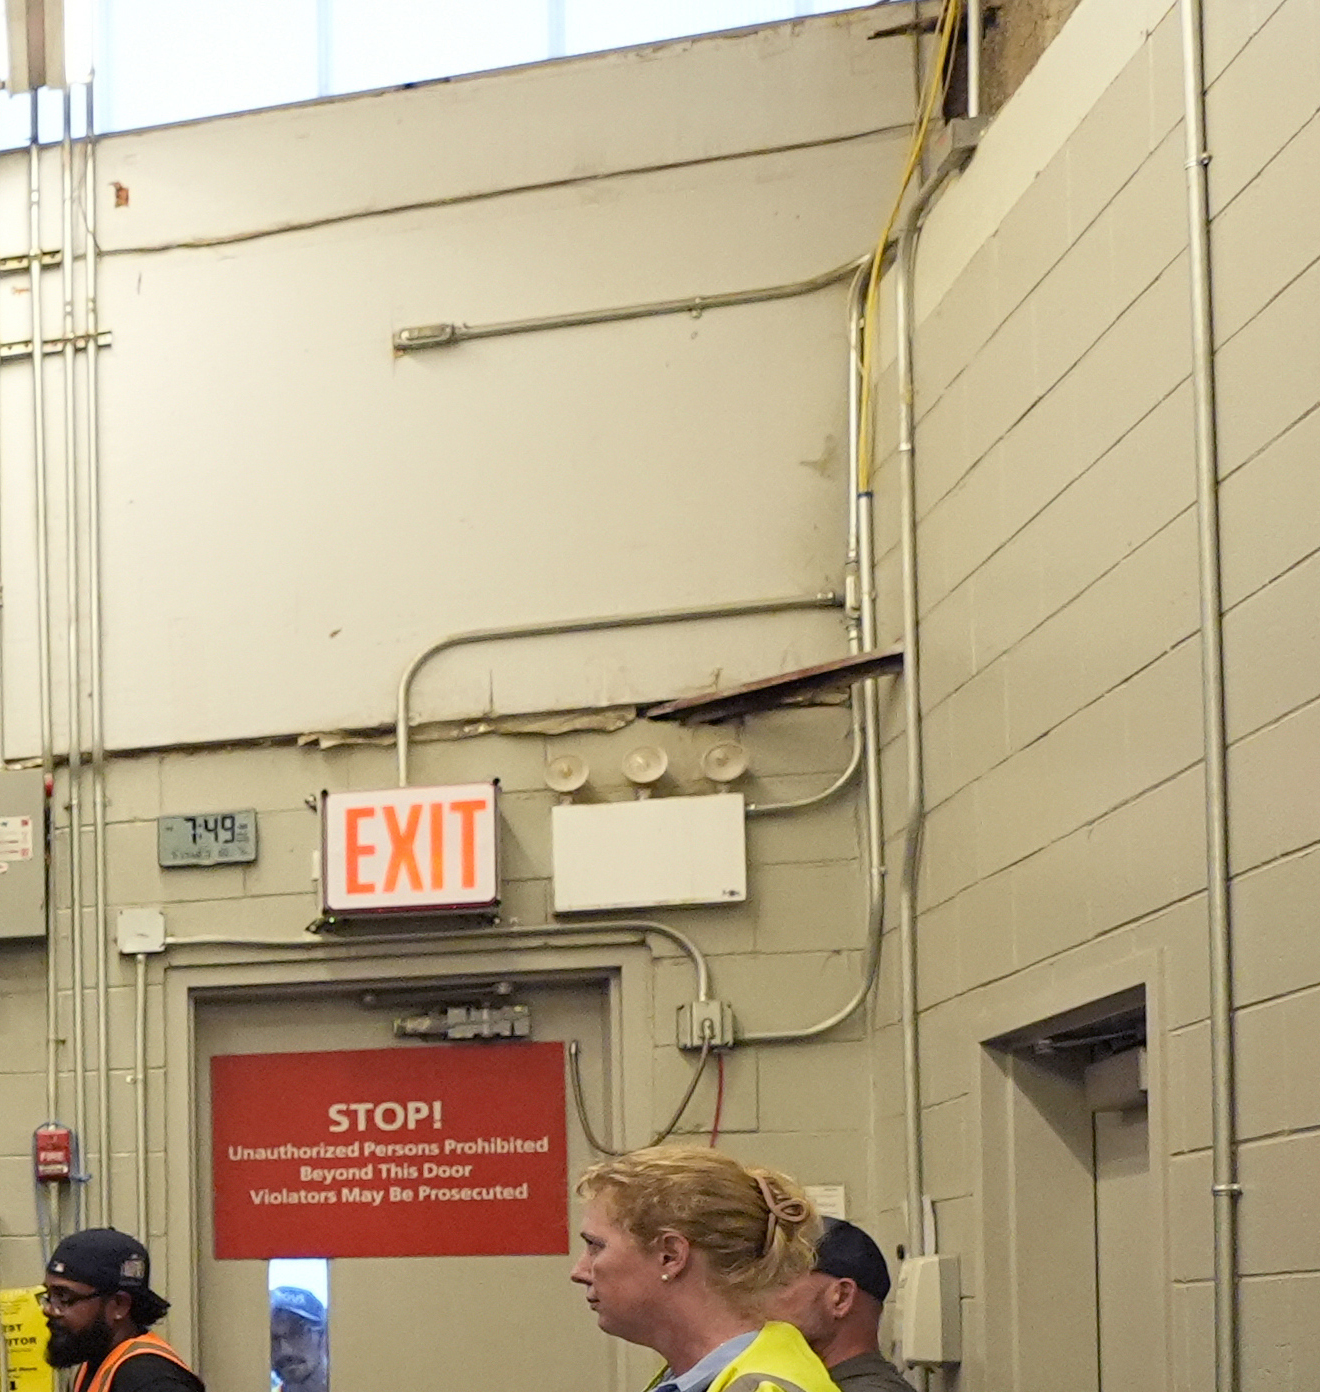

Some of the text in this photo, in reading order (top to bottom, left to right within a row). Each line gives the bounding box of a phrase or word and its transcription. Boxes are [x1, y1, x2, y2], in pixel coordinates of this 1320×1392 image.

[183, 815, 236, 844] 7:49
[344, 799, 488, 896] EXIT
[327, 1100, 443, 1133] STOP!
[228, 1136, 549, 1161] Unauthorized Persons Prohibited
[300, 1162, 473, 1185] Beyond This Door
[250, 1183, 529, 1206] Violators May Be Prosecuted
